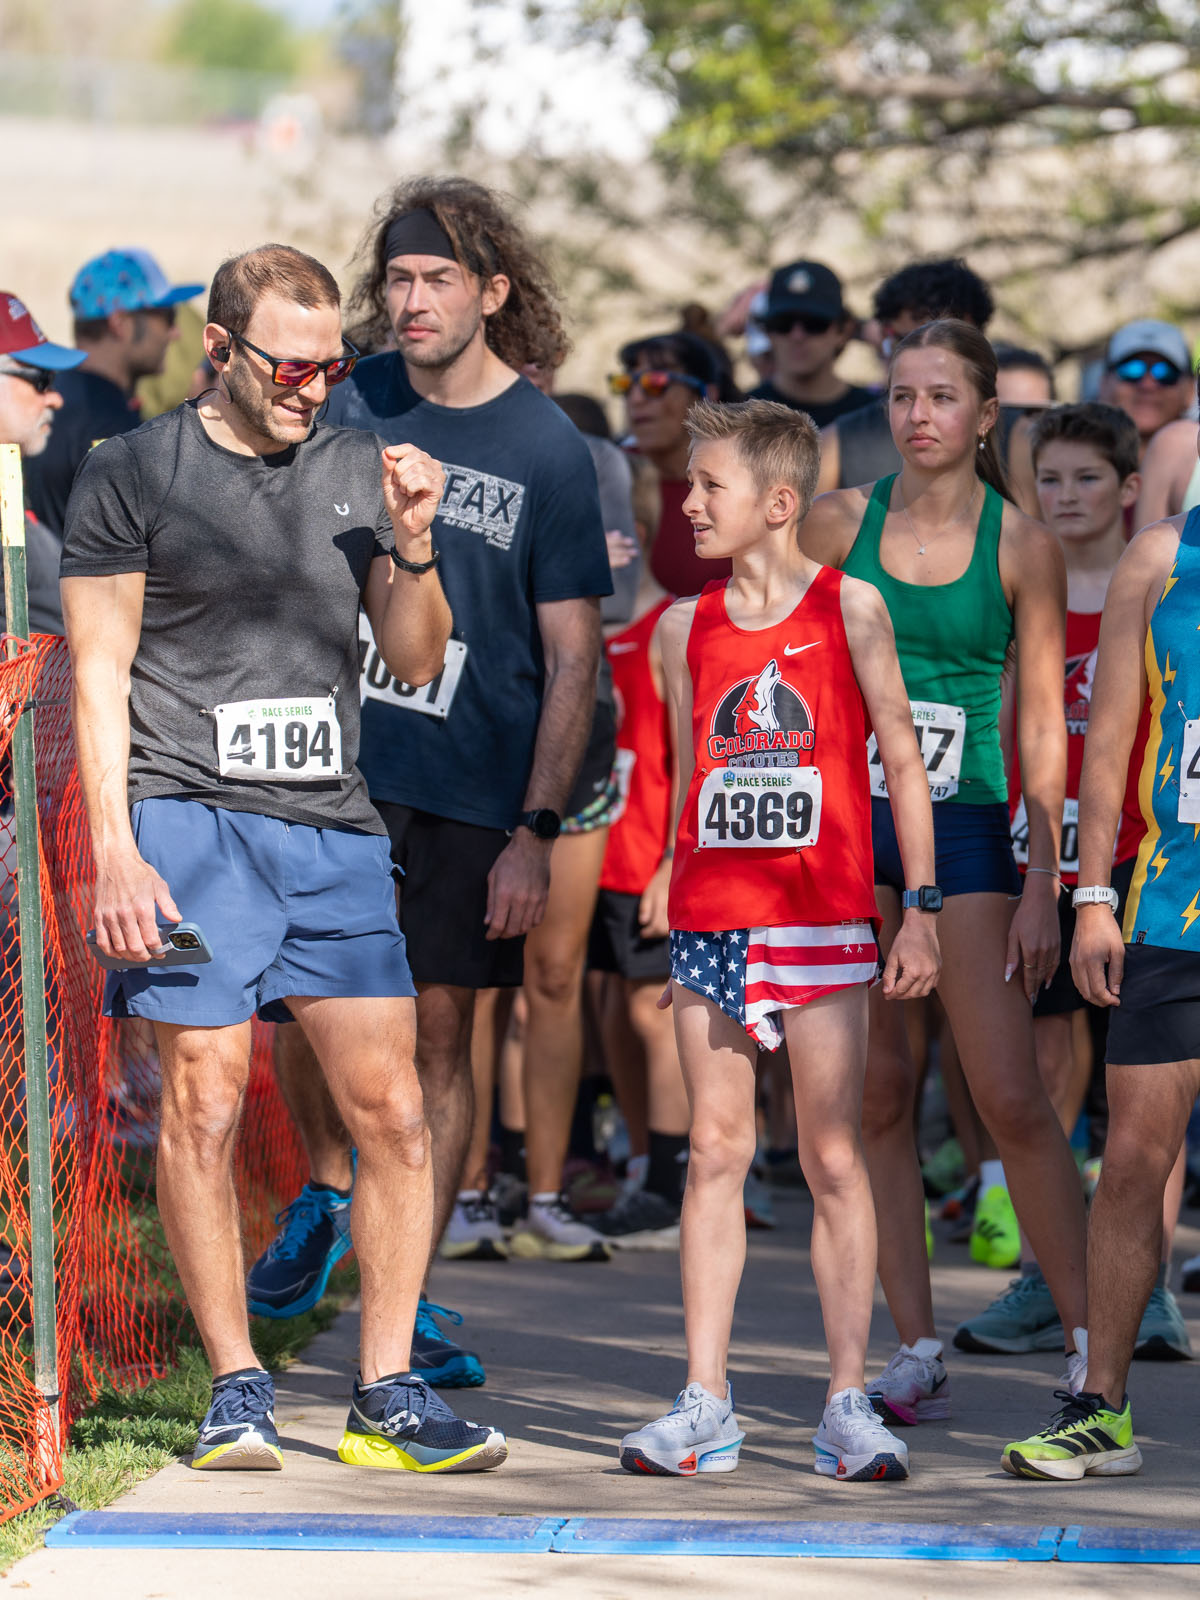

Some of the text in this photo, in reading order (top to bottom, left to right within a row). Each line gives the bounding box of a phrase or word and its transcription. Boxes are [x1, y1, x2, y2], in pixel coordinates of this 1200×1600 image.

[261, 706, 313, 717] RACE SERIES
[226, 721, 333, 769] 4194
[708, 730, 815, 759] COLORADO
[737, 777, 792, 787] RACE SERIES
[705, 791, 813, 840] 4369
